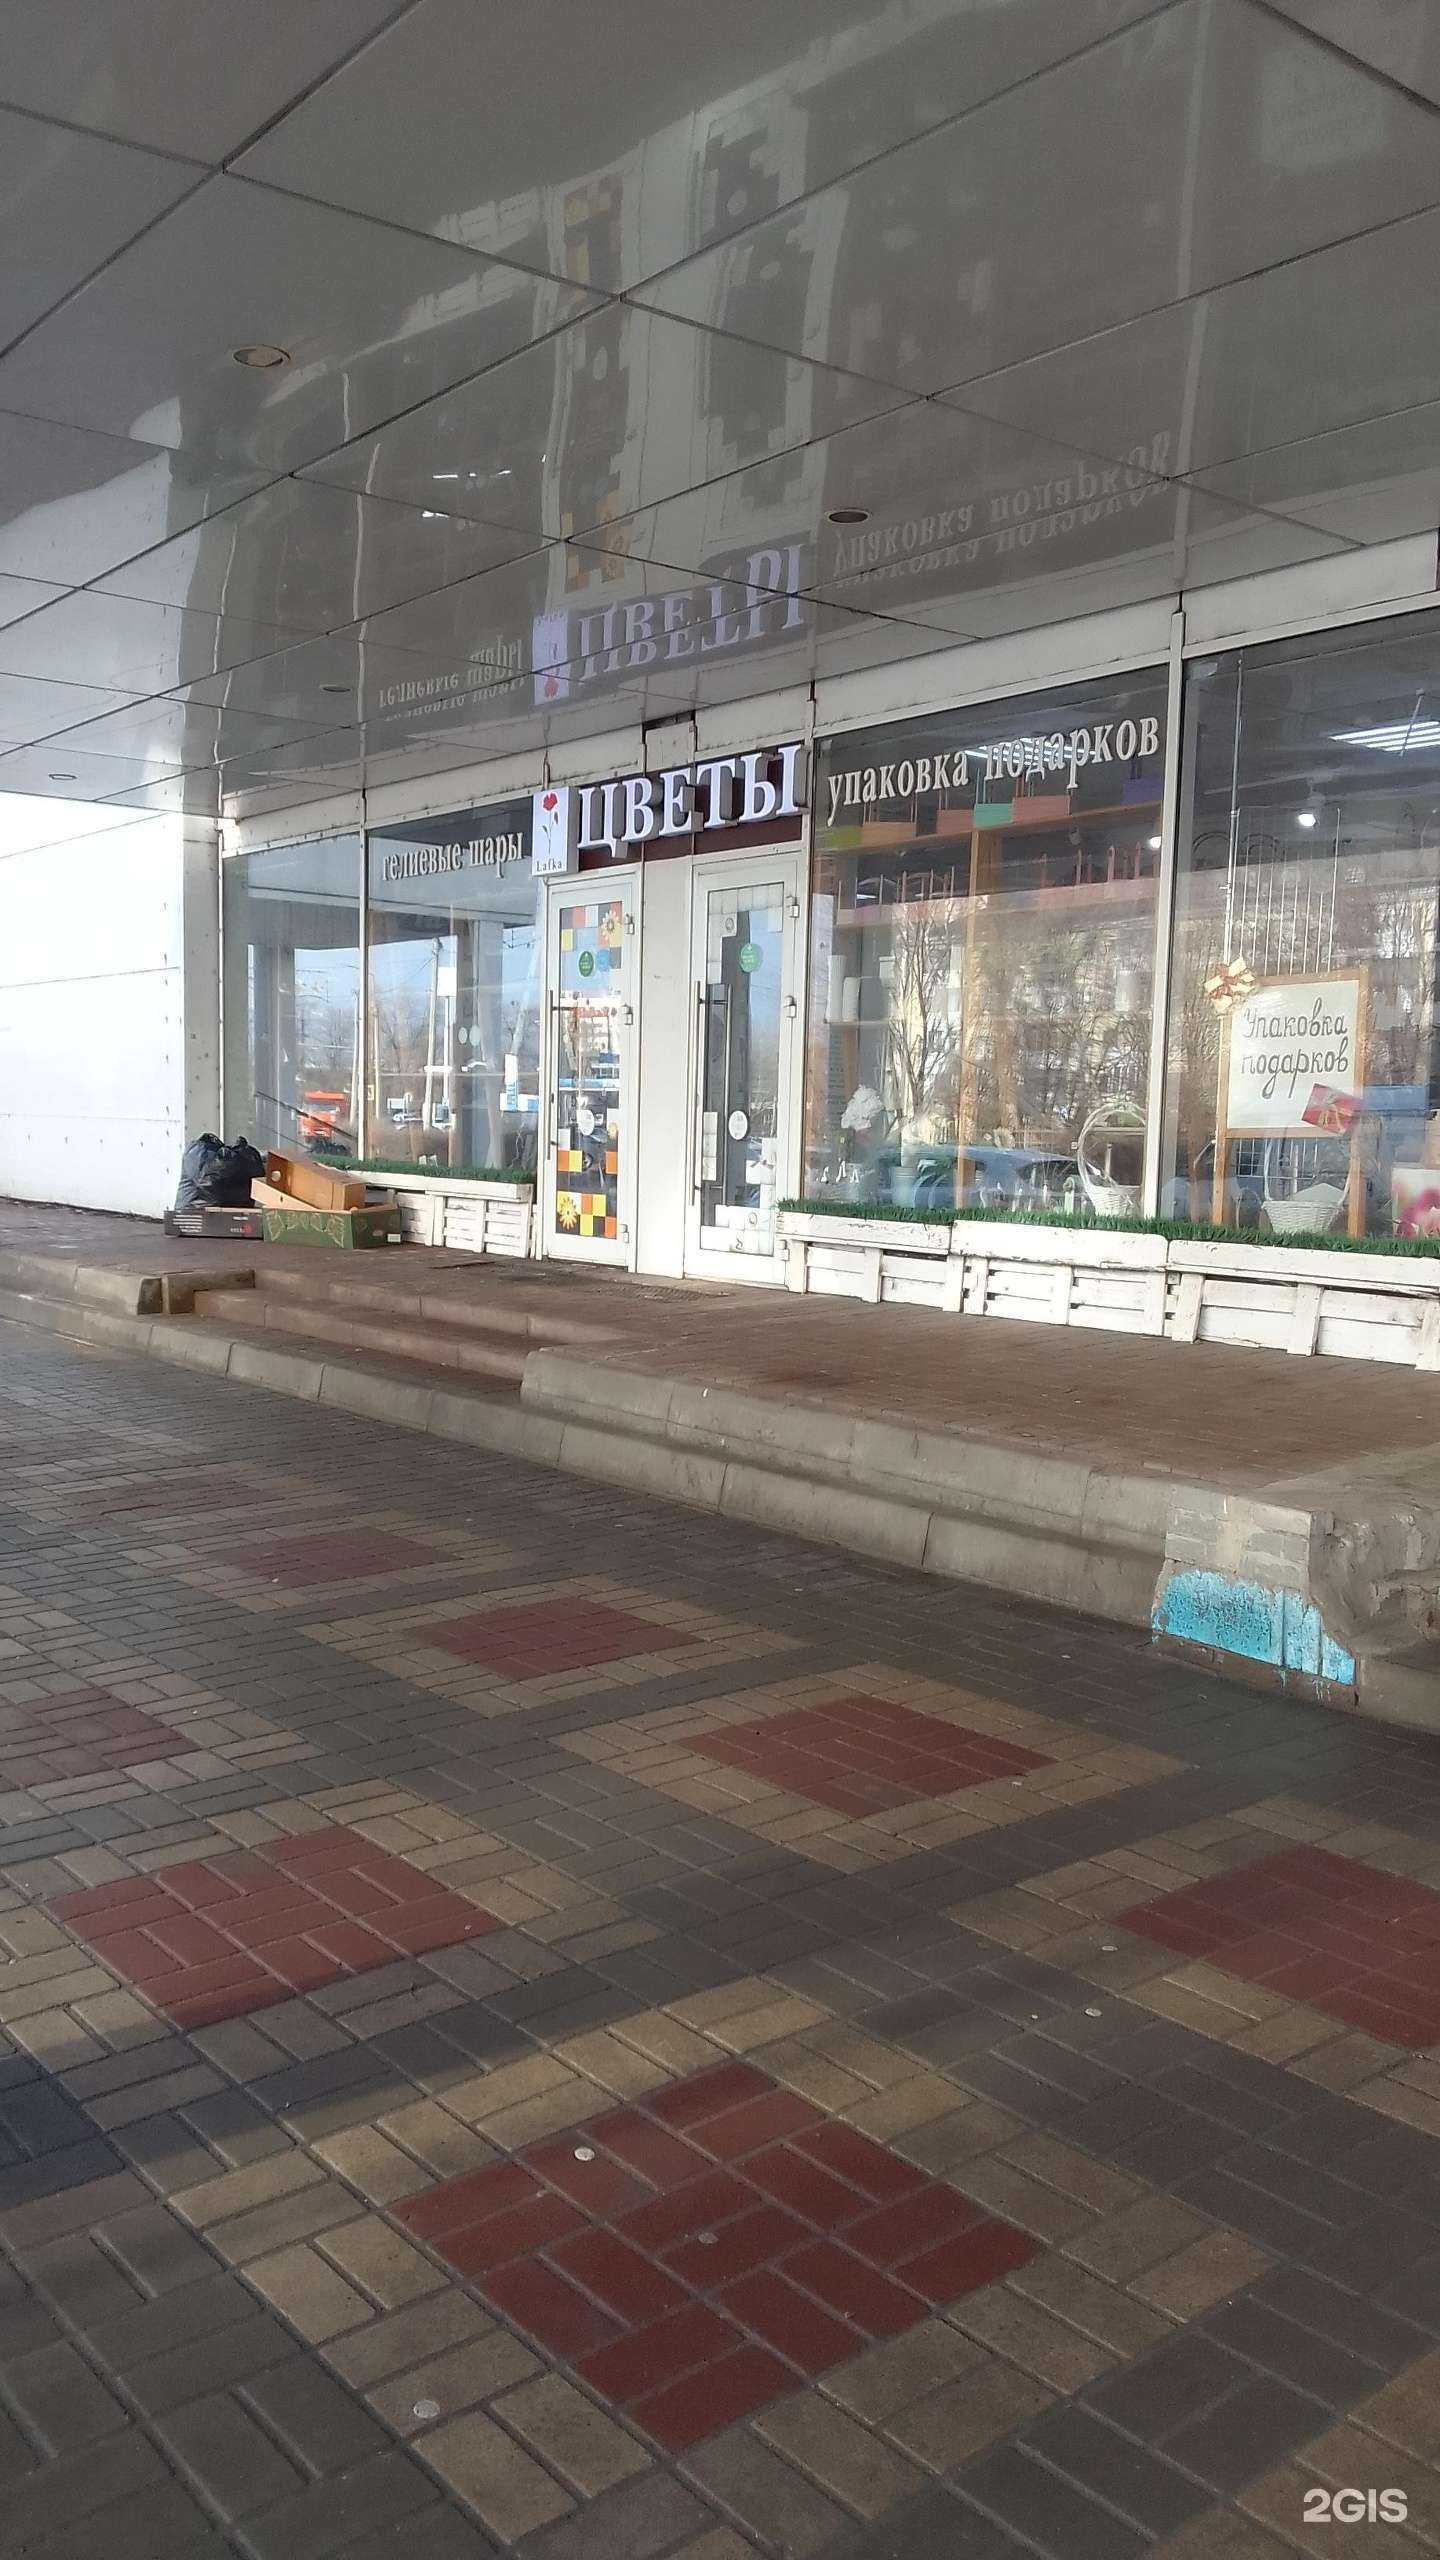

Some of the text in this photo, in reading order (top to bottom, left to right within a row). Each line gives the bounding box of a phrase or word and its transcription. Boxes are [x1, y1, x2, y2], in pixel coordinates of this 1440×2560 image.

[577, 744, 804, 856] ЦВЕТЫ
[827, 716, 1159, 827] упаковка подарков
[382, 831, 524, 881] гелиевые шары
[1242, 997, 1348, 1038] Упаковка
[1241, 1036, 1349, 1099] подарков
